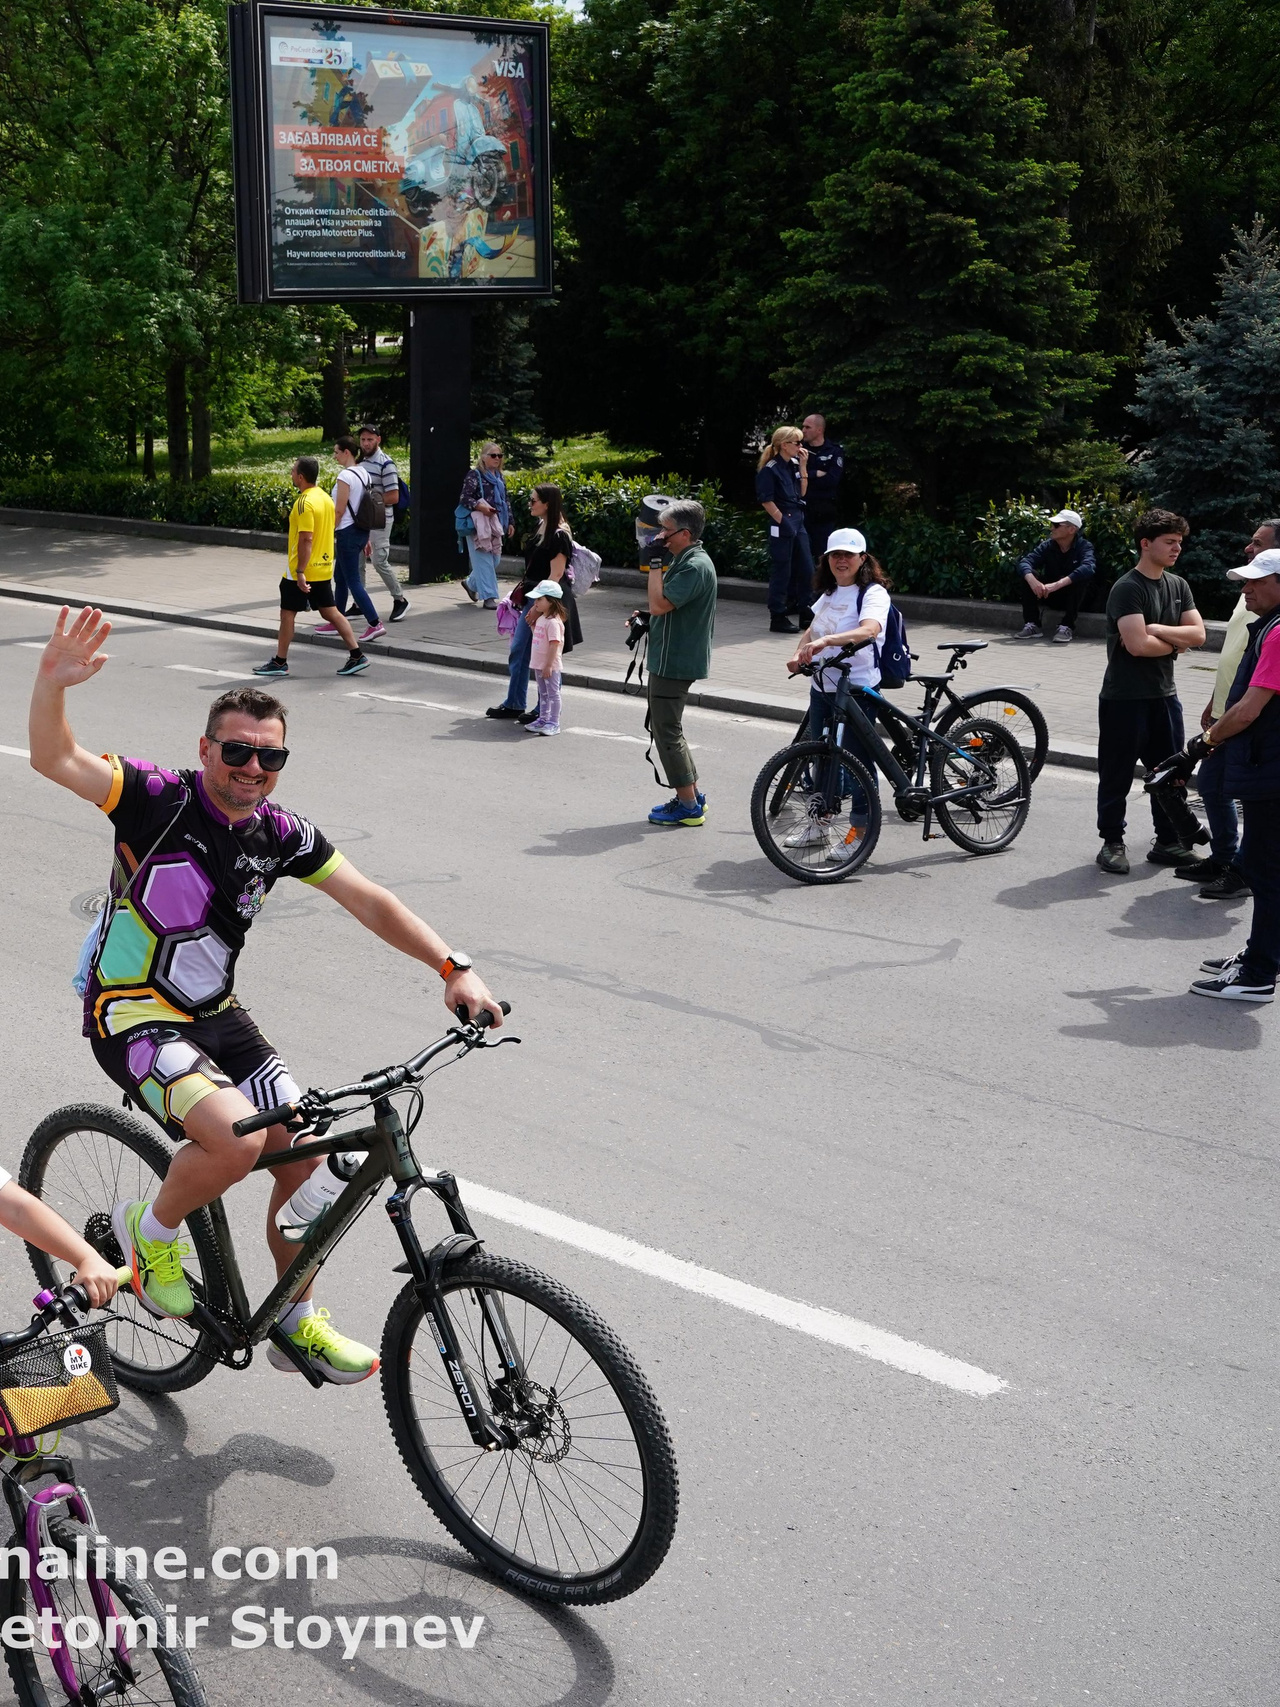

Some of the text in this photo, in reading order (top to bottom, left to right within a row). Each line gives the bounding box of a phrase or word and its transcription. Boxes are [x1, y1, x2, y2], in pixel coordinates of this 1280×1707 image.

[492, 60, 525, 79] VISA
[278, 131, 378, 147] ЗАБАВЛЯВАЙ СЕ
[300, 158, 400, 173] ЗА ТВОЯ СМЕТКА
[284, 206, 314, 217] Открий
[315, 208, 340, 216] сметка
[346, 207, 379, 216] ProCredit
[285, 217, 315, 227] плащай
[320, 218, 335, 226] Visa
[341, 218, 373, 228] участвай
[292, 230, 321, 239] скутера
[321, 229, 357, 237] Motoretta
[358, 229, 375, 237] Plus.
[286, 250, 310, 260] Научи
[346, 250, 406, 260] procreditbank.bg
[68, 1349, 72, 1357] I
[70, 1355, 83, 1363] MY
[70, 1361, 88, 1370] BIKE
[449, 1359, 477, 1417] ZERON
[505, 1568, 593, 1595] RACING RAY
